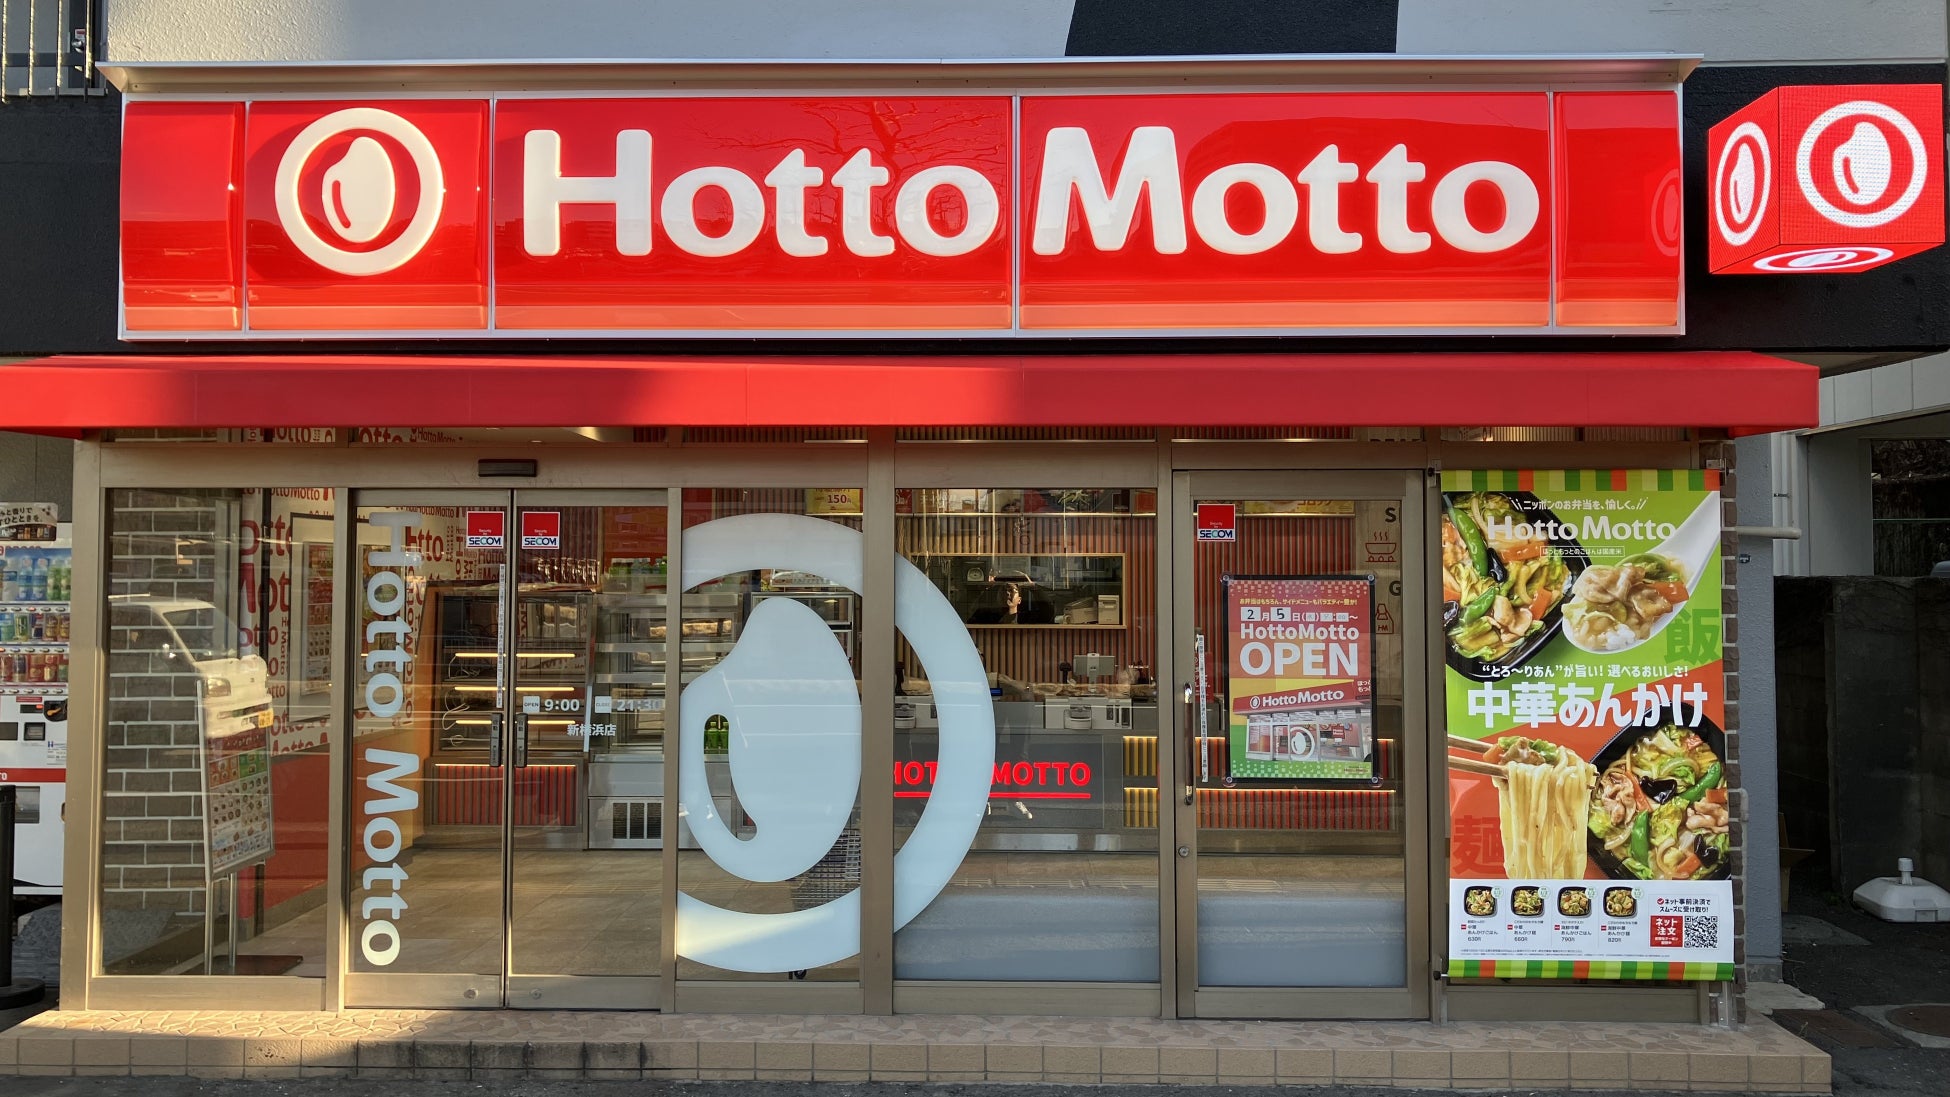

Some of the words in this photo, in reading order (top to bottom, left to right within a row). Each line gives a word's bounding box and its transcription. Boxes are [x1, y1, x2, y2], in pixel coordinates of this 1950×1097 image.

[523, 129, 998, 258] Hotto
[1032, 126, 1540, 255] Motto
[1200, 530, 1232, 538] SECOM
[1487, 515, 1578, 540] Hotto
[1582, 515, 1676, 540] Motto
[469, 537, 501, 545] SECOM
[524, 538, 557, 546] SECOM
[365, 511, 423, 718] Hotto
[1239, 642, 1359, 676] OPEN
[544, 699, 580, 711] 9:00
[616, 699, 660, 711] 21:30
[1467, 681, 1708, 729] 中華あんかけ
[991, 761, 1092, 786] MOTTO
[361, 748, 420, 966] Motto
[1655, 918, 1678, 927] ネット
[1656, 927, 1677, 937] 注文
